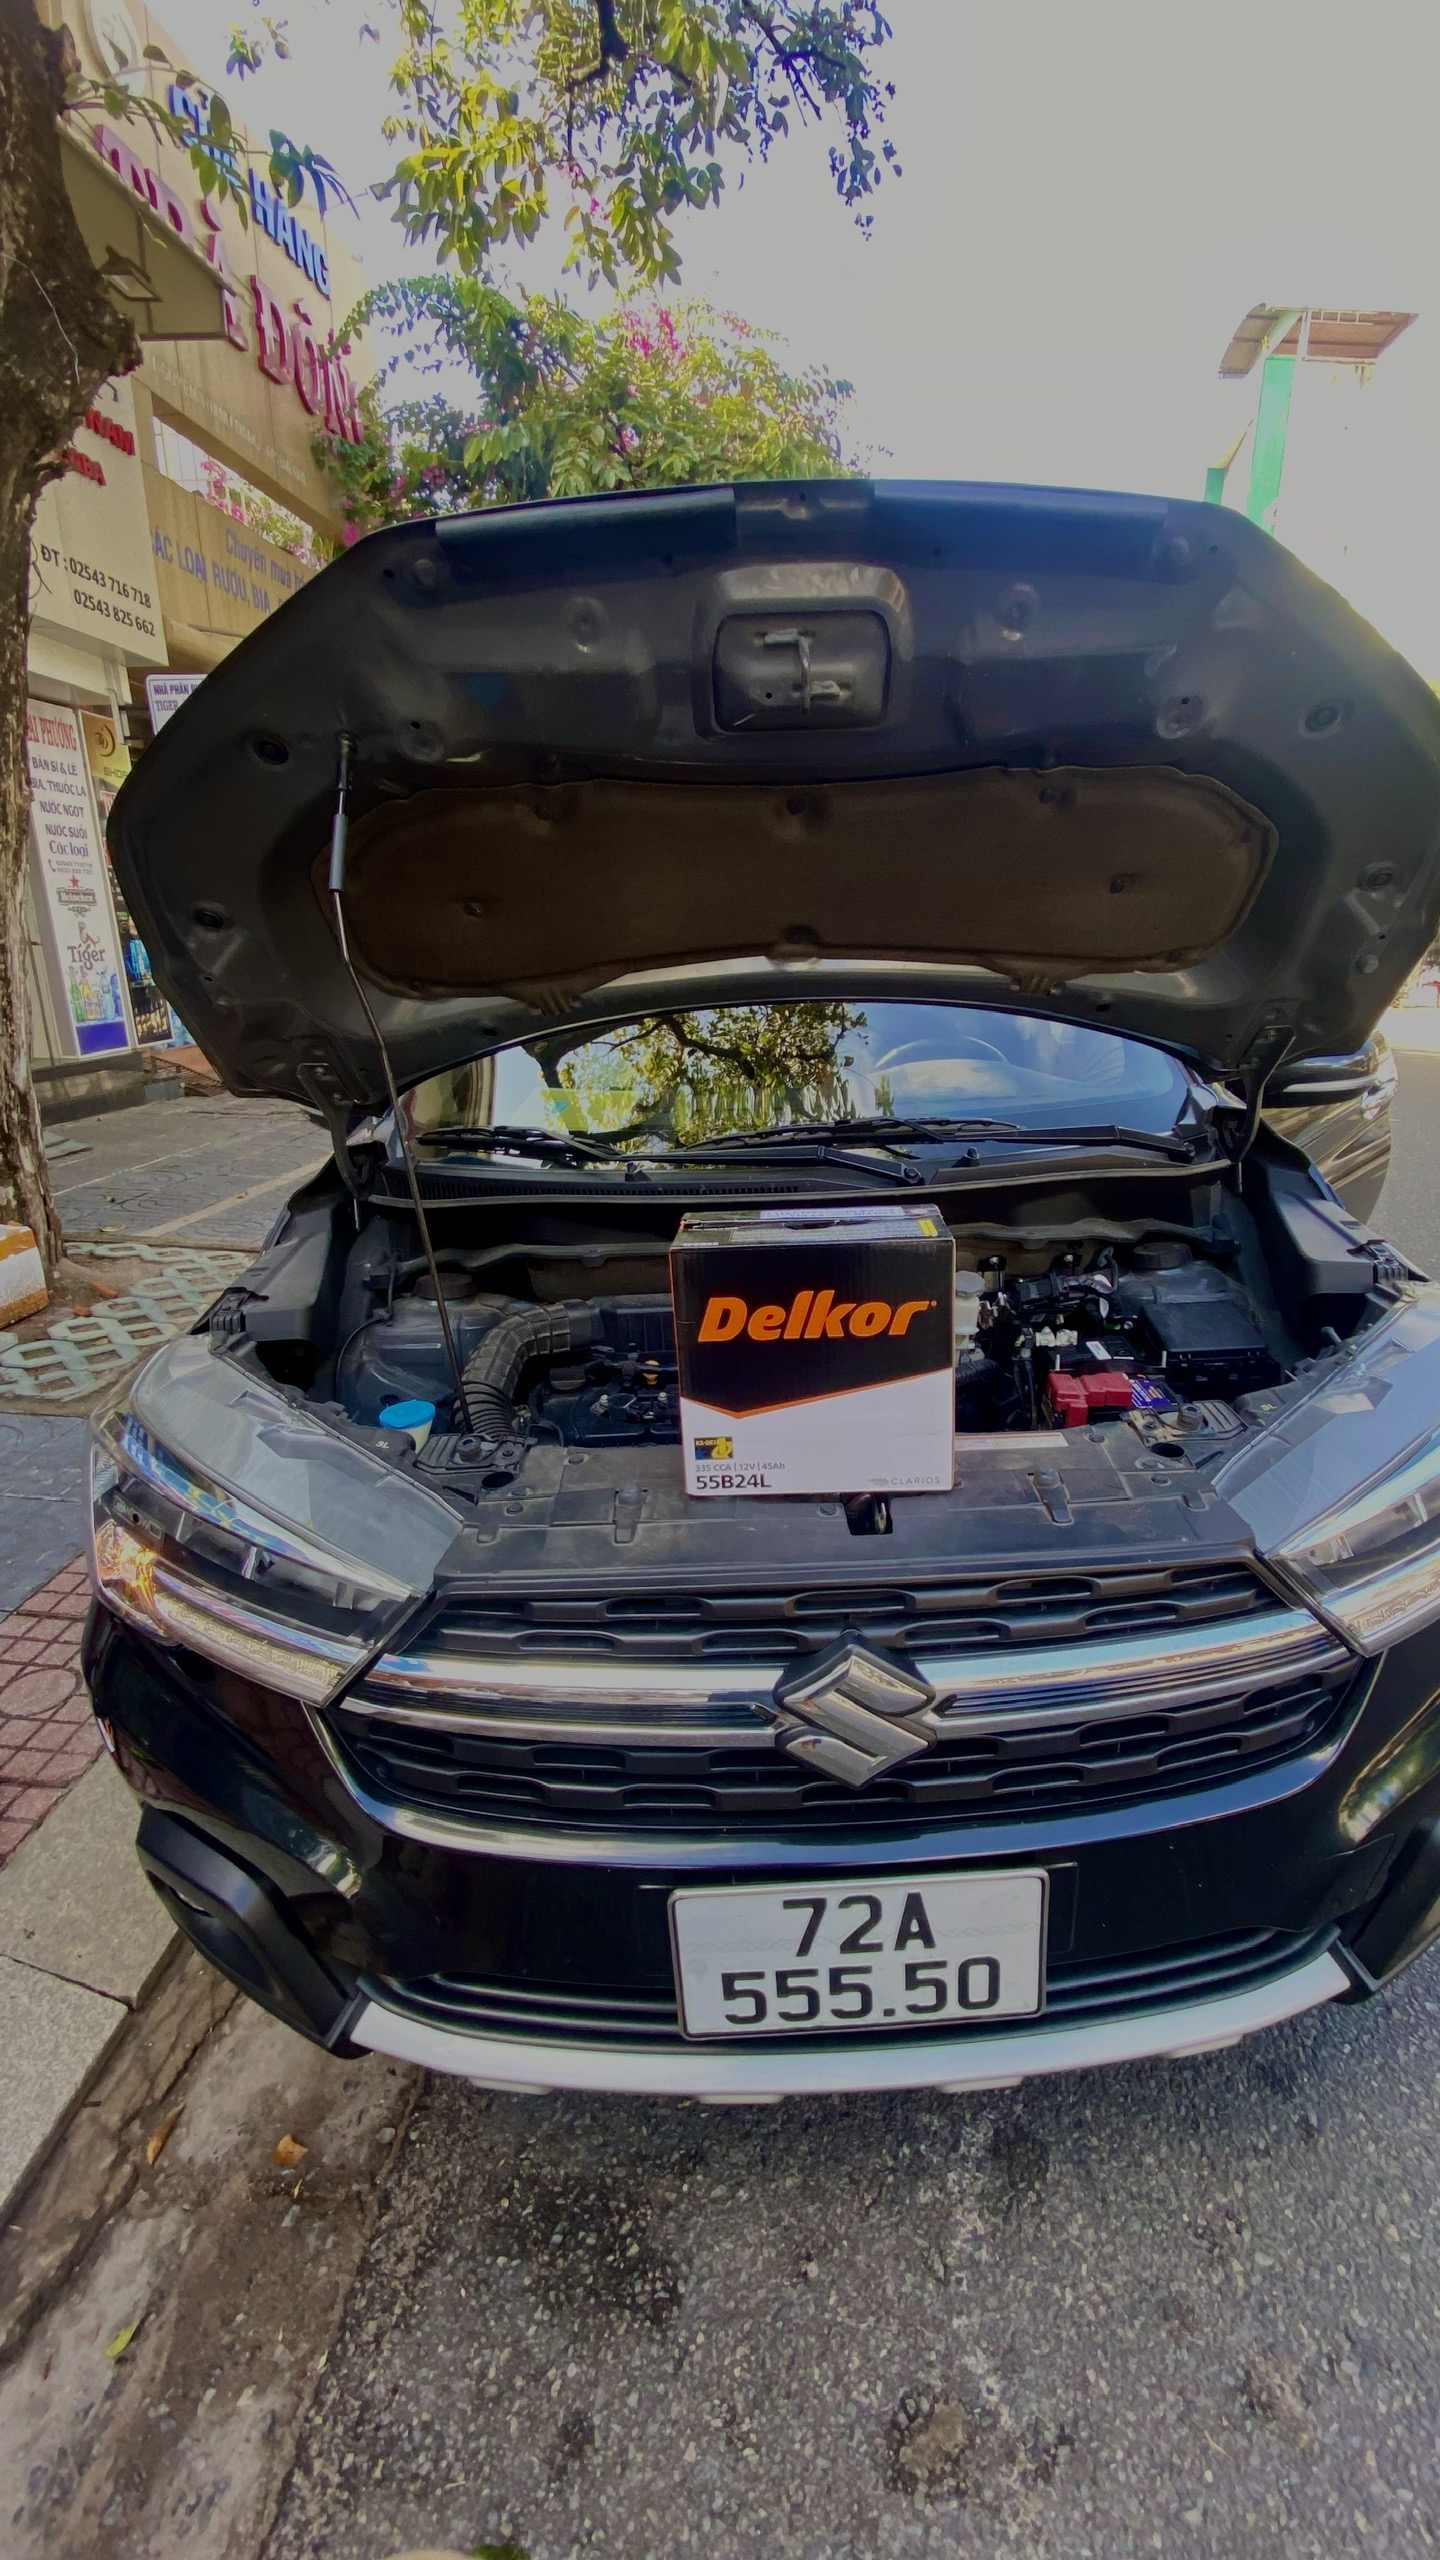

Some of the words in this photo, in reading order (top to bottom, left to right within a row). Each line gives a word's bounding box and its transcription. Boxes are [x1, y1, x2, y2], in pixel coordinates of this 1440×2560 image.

[40, 543, 60, 567] ĐT
[107, 575, 130, 599] 716
[130, 586, 152, 609] 718
[73, 588, 111, 618] 02543
[112, 606, 134, 628] 825
[134, 616, 156, 637] 662
[49, 839, 69, 856] Các
[698, 1289, 929, 1342] Delkor
[695, 1463, 712, 1472] 335
[713, 1463, 732, 1472] CCA
[739, 1462, 756, 1471] 12V
[761, 1461, 786, 1471] 45Ah
[696, 1473, 772, 1490] 55B24L
[890, 1476, 941, 1486] CLARIOS
[782, 1891, 936, 1957] 72A
[720, 1955, 1001, 2024] 555.50
